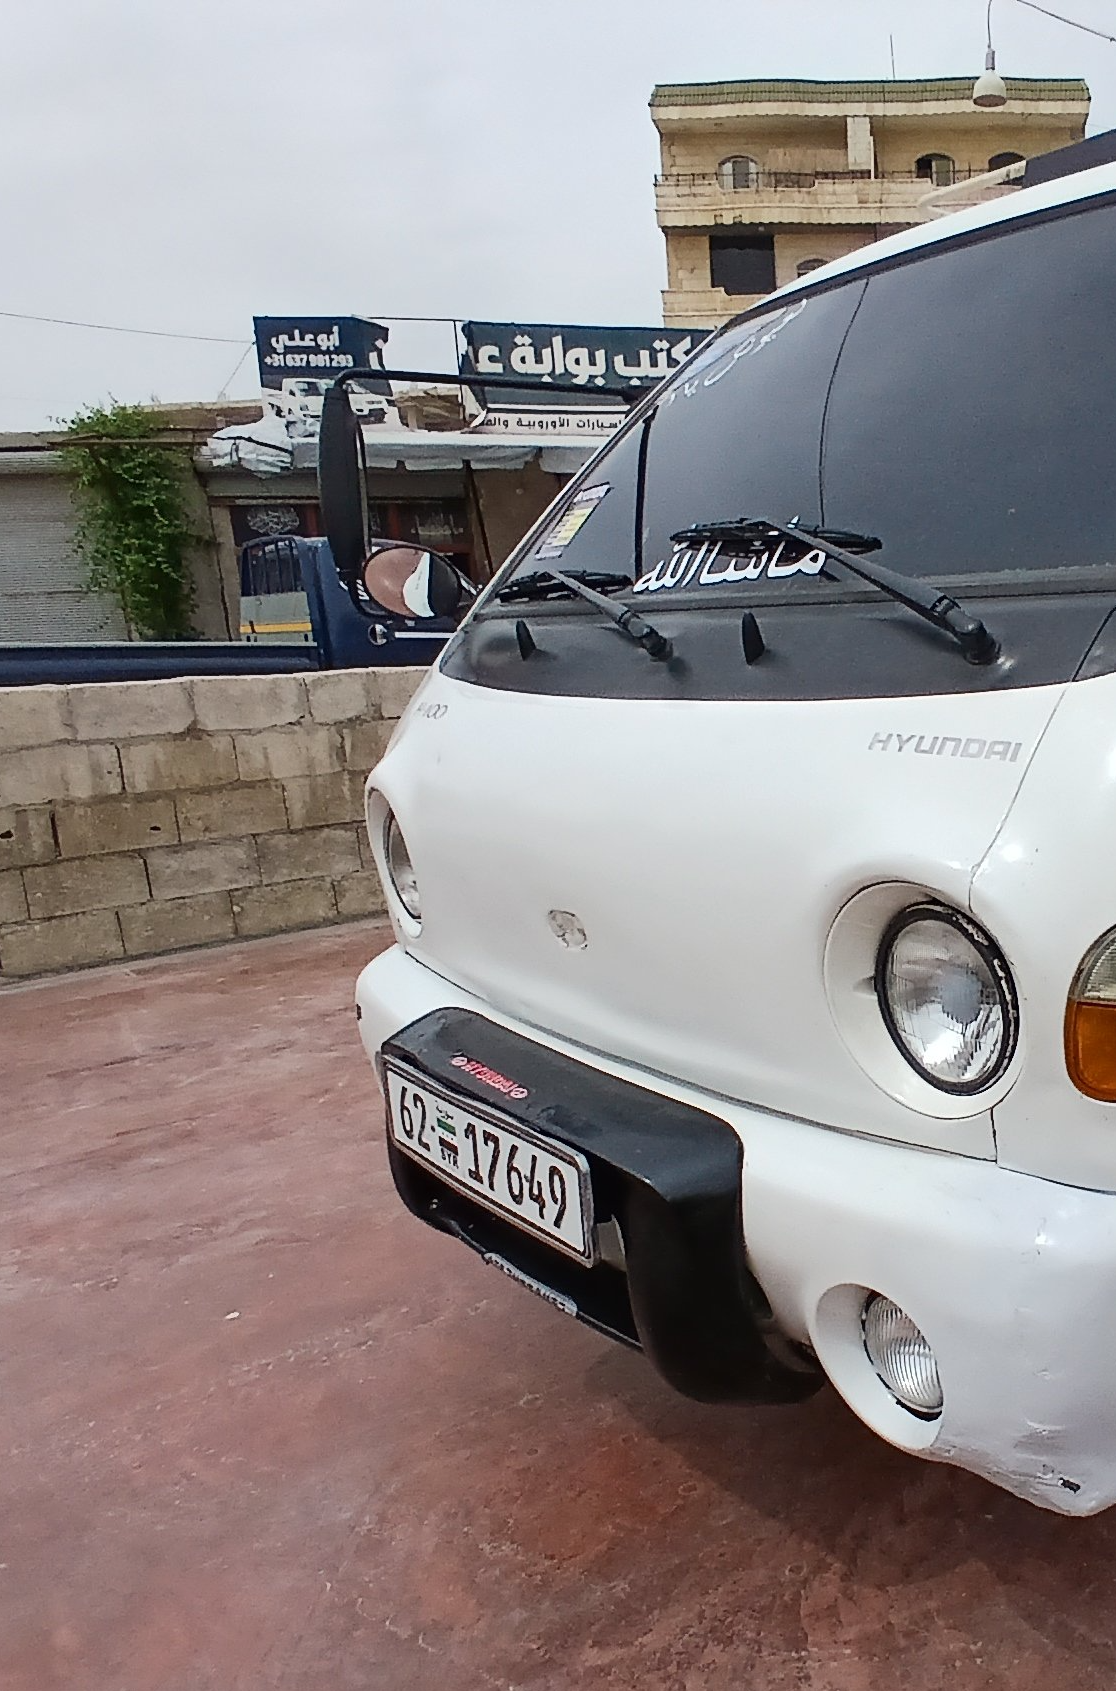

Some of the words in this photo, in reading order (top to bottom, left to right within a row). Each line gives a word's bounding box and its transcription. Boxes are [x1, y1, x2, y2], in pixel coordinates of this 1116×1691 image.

[509, 334, 607, 387] بوابة
[613, 335, 692, 386] كتب
[867, 731, 1023, 763] HYUNDAI
[400, 1086, 431, 1152] 62
[464, 1122, 568, 1230] 17649
[440, 1148, 460, 1170] SYR
